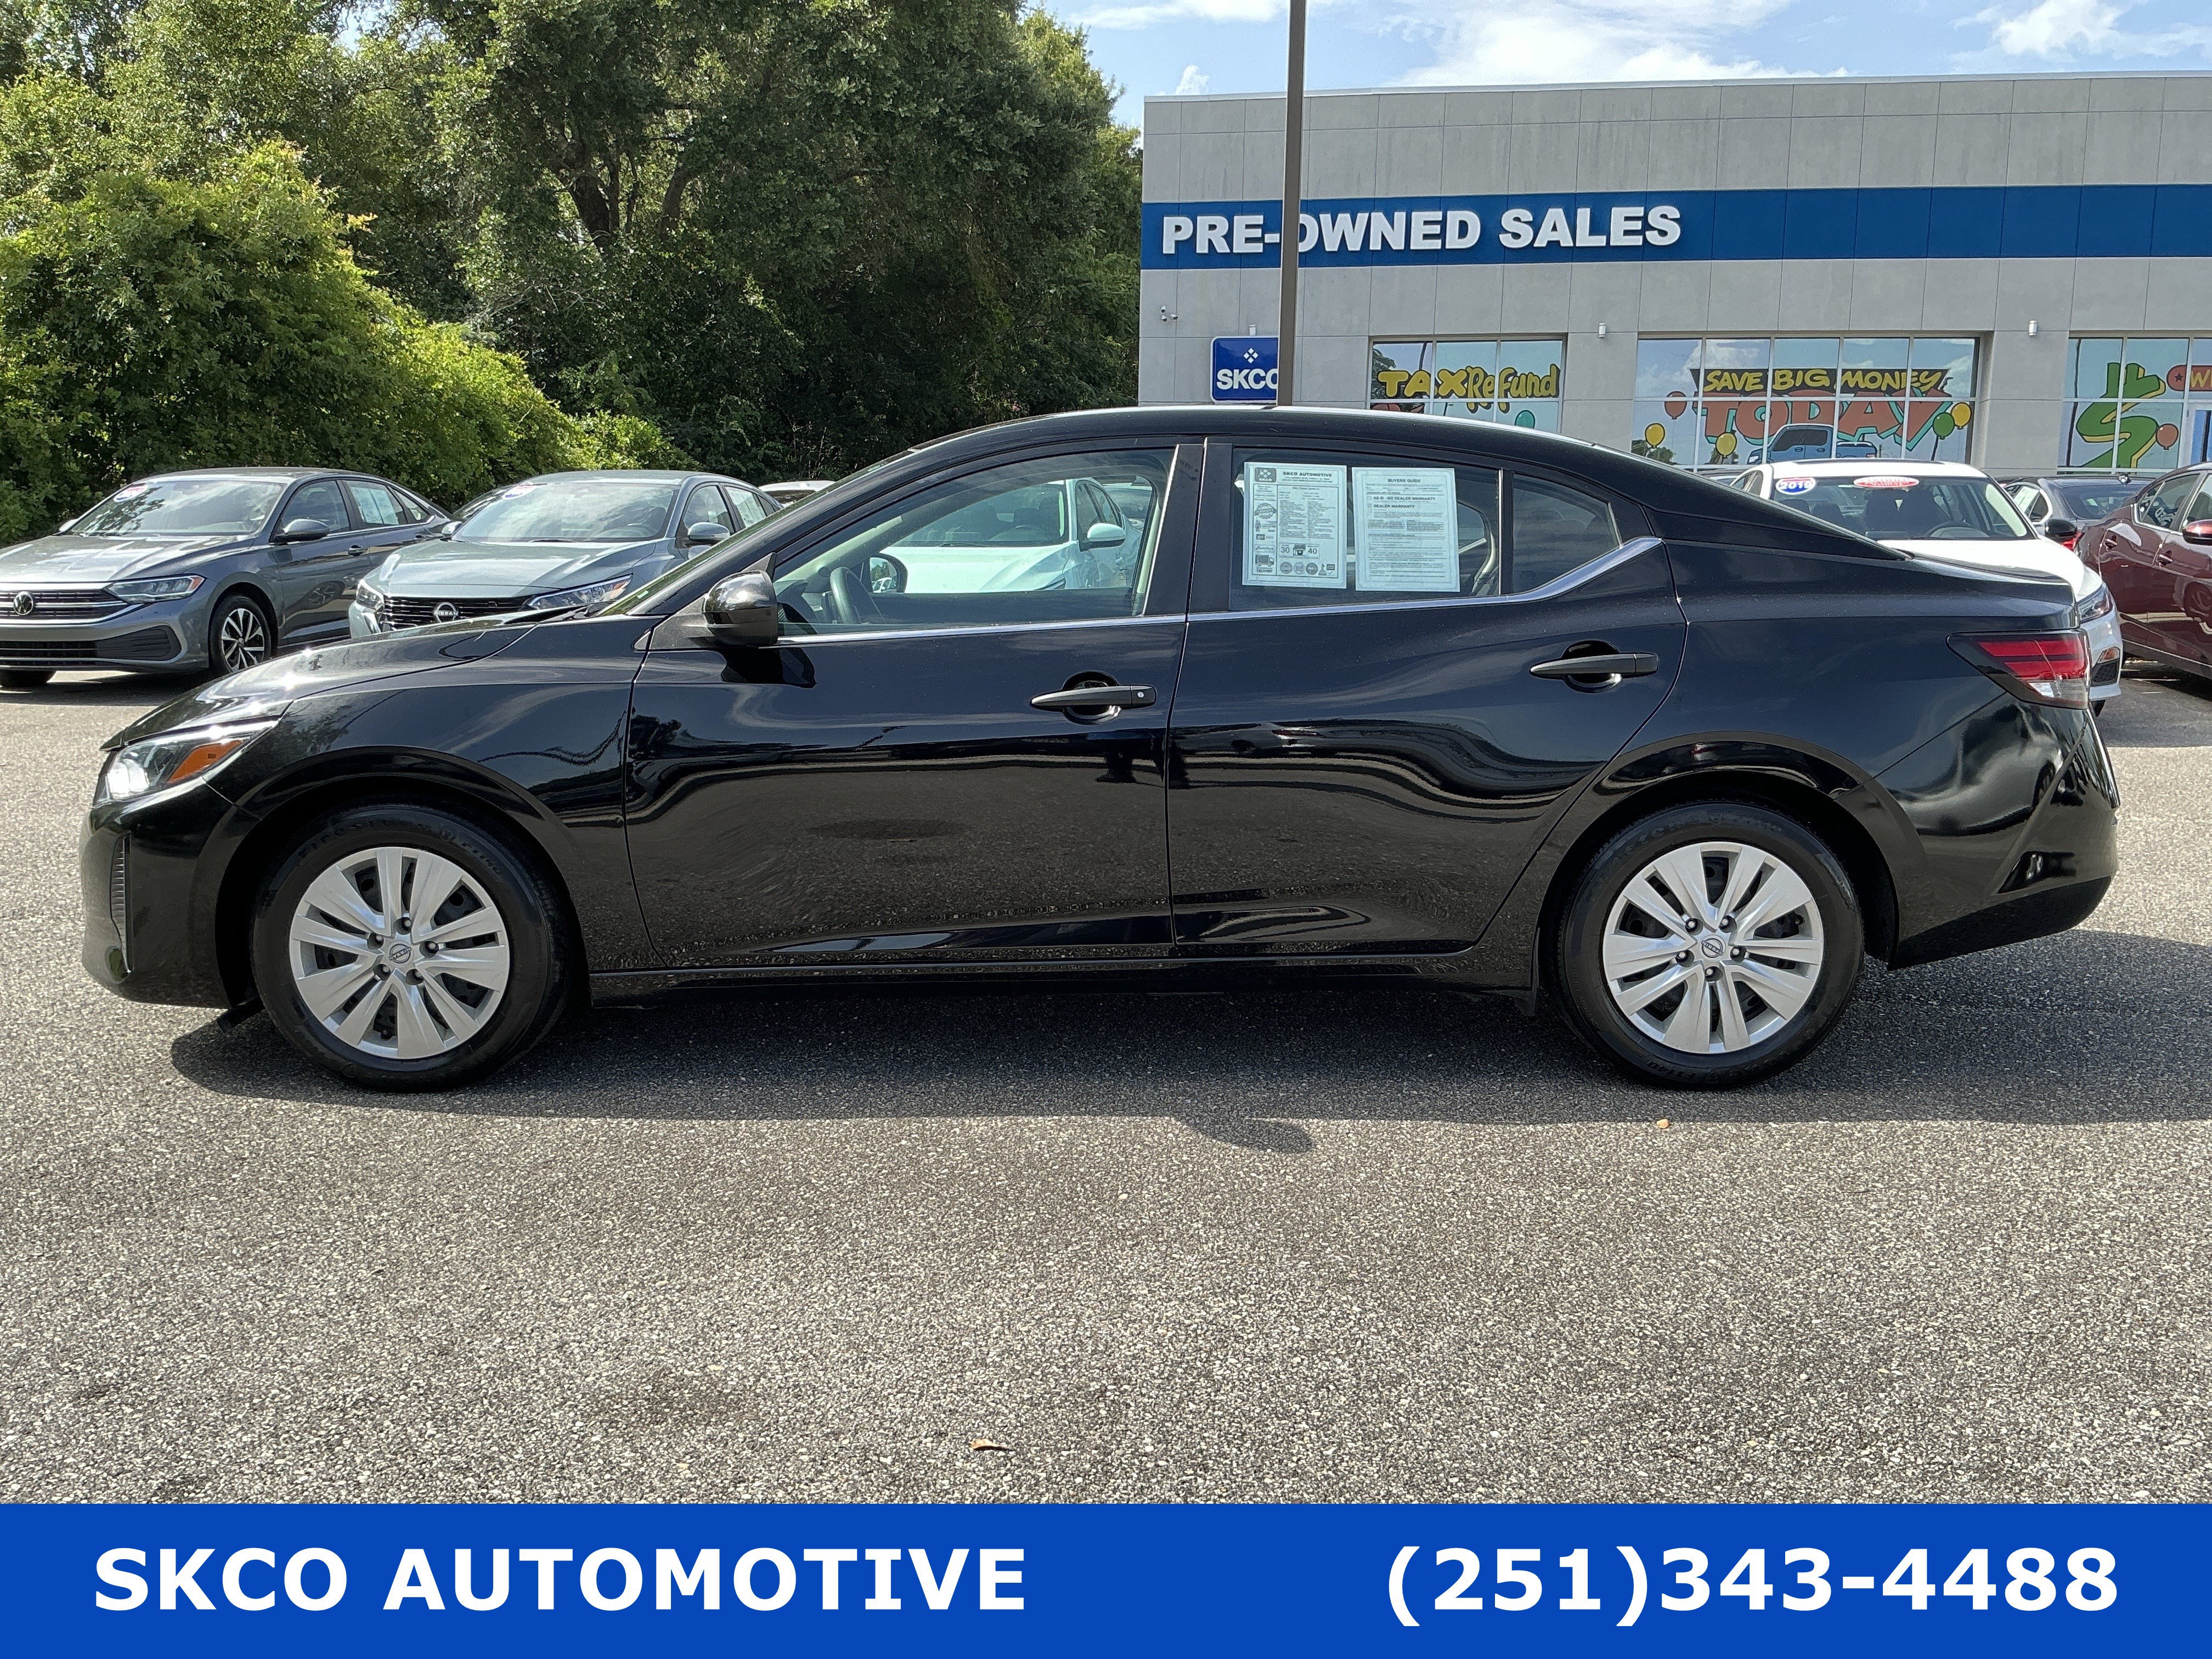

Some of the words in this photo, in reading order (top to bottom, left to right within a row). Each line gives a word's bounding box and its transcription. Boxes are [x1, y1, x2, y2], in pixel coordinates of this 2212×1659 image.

[1499, 205, 1681, 249] SALES
[1378, 369, 1468, 398] TAX
[1703, 370, 1764, 392] SAVE
[1771, 368, 1830, 390] BIG
[1833, 370, 1943, 392] MONEY
[1694, 388, 1952, 450] TODAY
[1701, 940, 1724, 956] NISSAN
